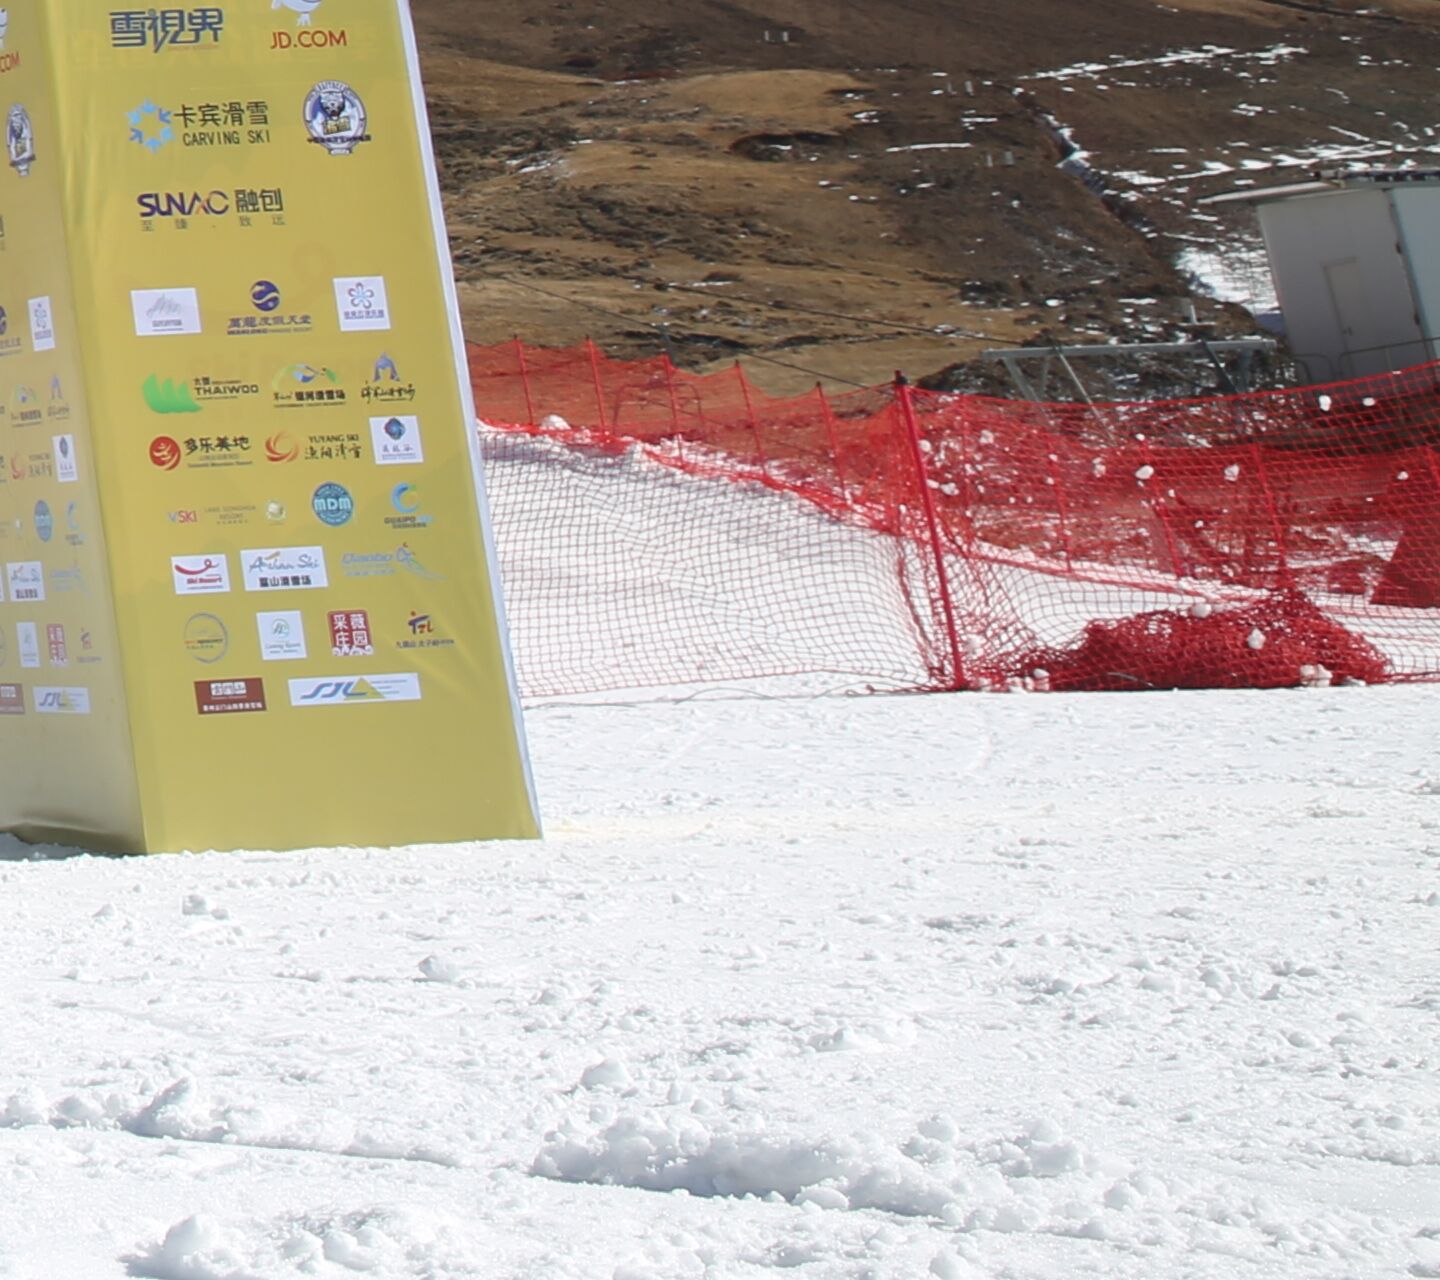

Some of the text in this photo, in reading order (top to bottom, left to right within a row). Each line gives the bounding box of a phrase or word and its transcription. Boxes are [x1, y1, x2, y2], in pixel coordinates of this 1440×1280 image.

[270, 29, 348, 49] JD.COM
[173, 100, 270, 128] 卡宾滑雪
[182, 128, 271, 147] CARVING SKI
[136, 188, 284, 217] SUNAC 融创
[194, 384, 260, 396] THAIWOO
[183, 436, 251, 456] 多乐美地
[308, 433, 360, 443] YUYANG SKI
[314, 497, 352, 511] MDM
